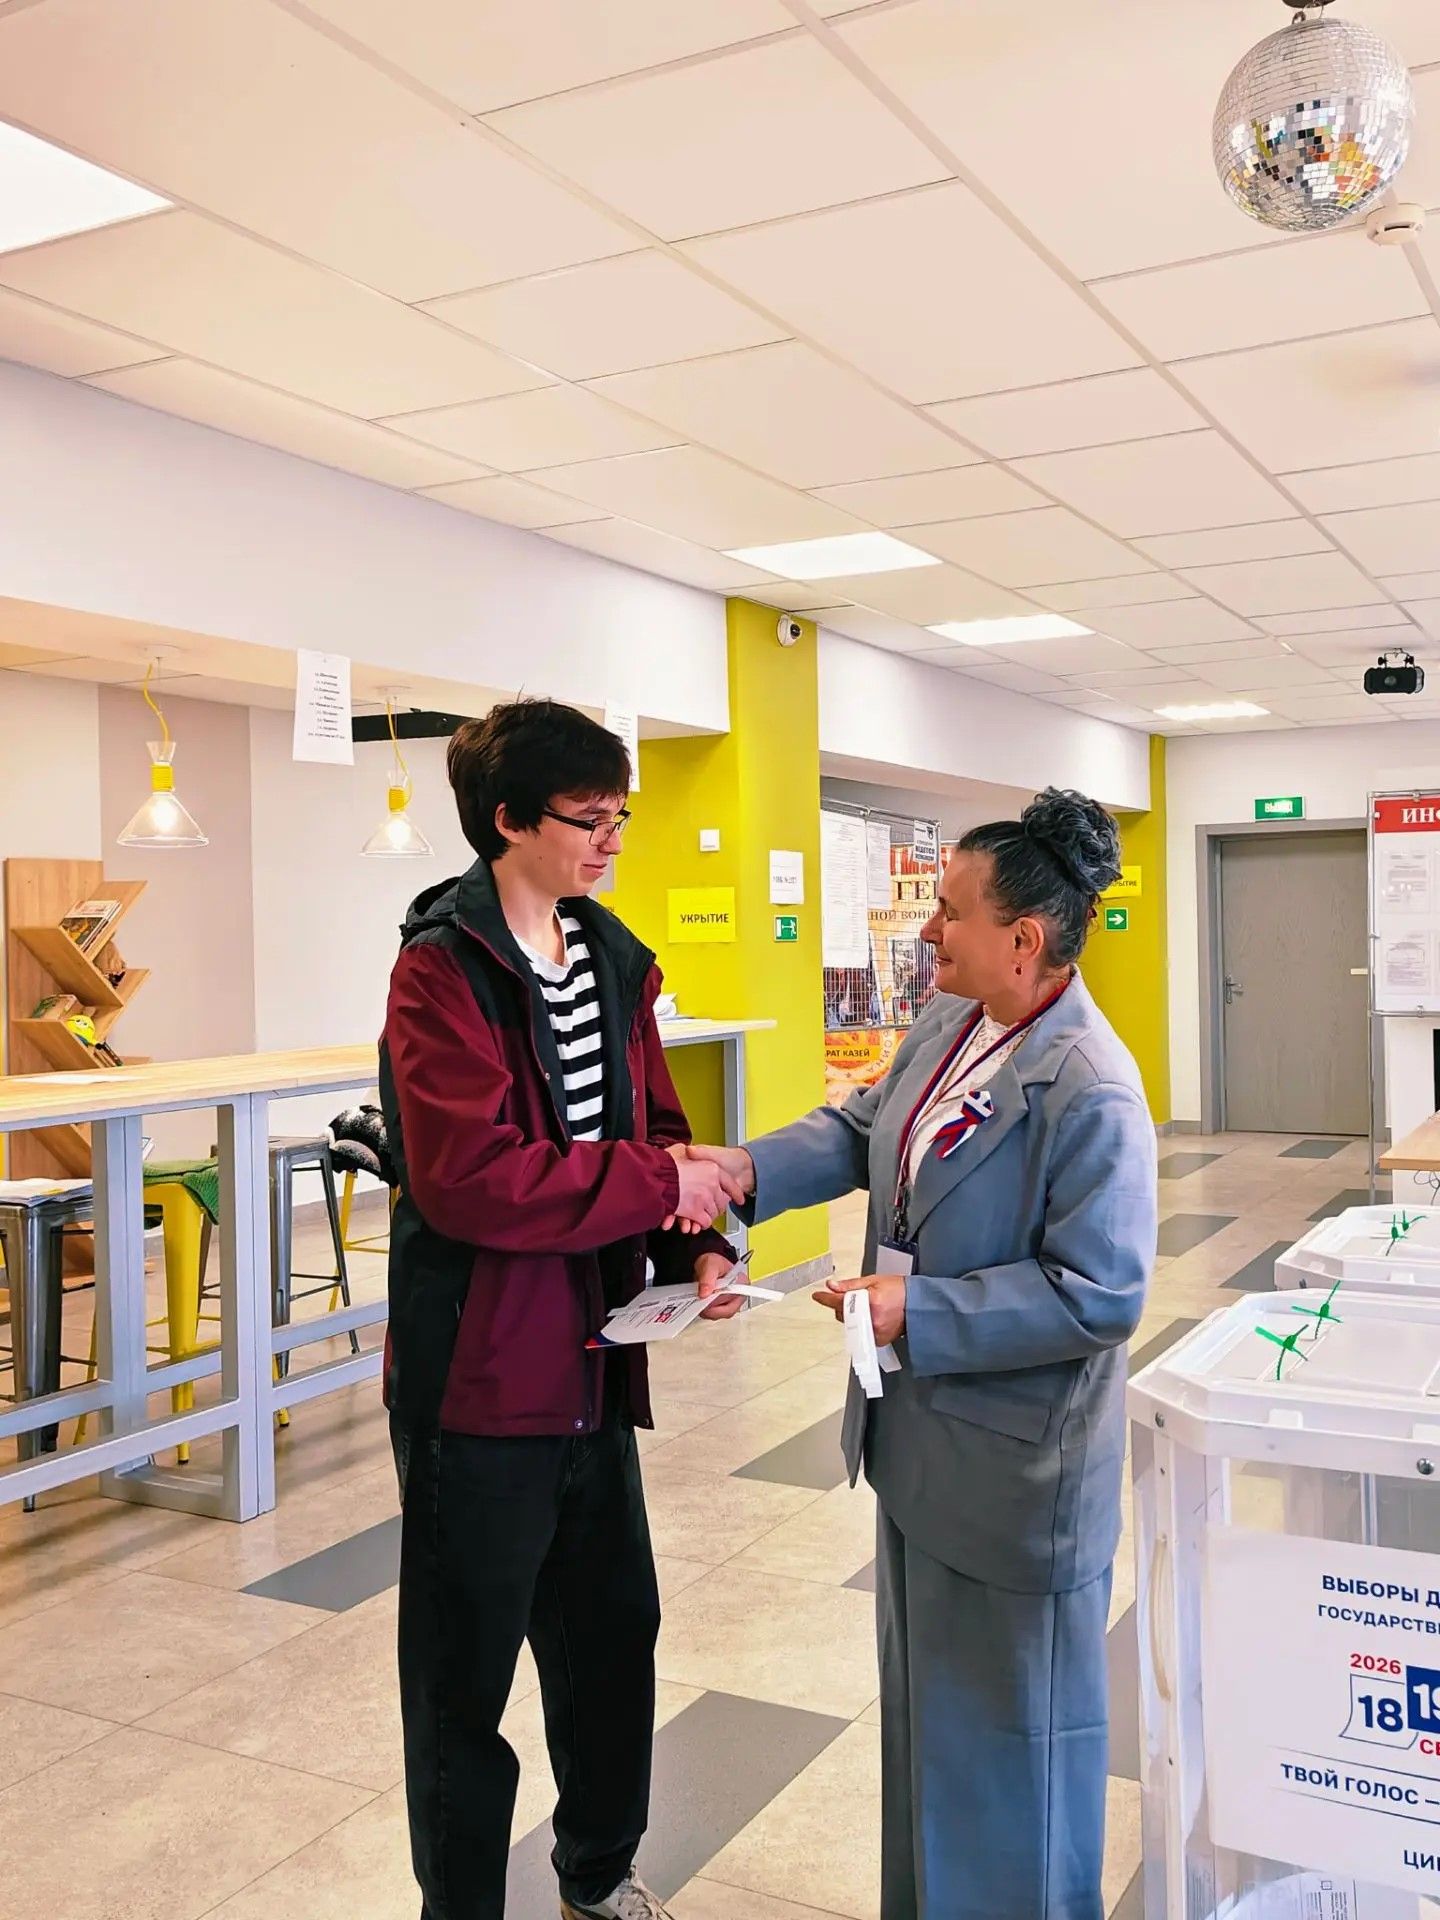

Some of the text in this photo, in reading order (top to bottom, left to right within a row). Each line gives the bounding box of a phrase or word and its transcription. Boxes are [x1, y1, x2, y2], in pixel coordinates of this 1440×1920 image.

[896, 880, 937, 901] ГЕ
[680, 913, 729, 924] УКРЫТИЕ
[843, 1048, 871, 1058] КАЗЕЙ
[1322, 1575, 1420, 1604] ВЫБОРЫ
[1318, 1604, 1440, 1635] ГОСУДАРСТВ
[1350, 1653, 1402, 1675] 2026
[1357, 1694, 1404, 1733] 18
[1280, 1763, 1339, 1790] ТВОЙ
[1345, 1777, 1419, 1806] ГОЛОС
[1403, 1849, 1440, 1872] ЦИ
